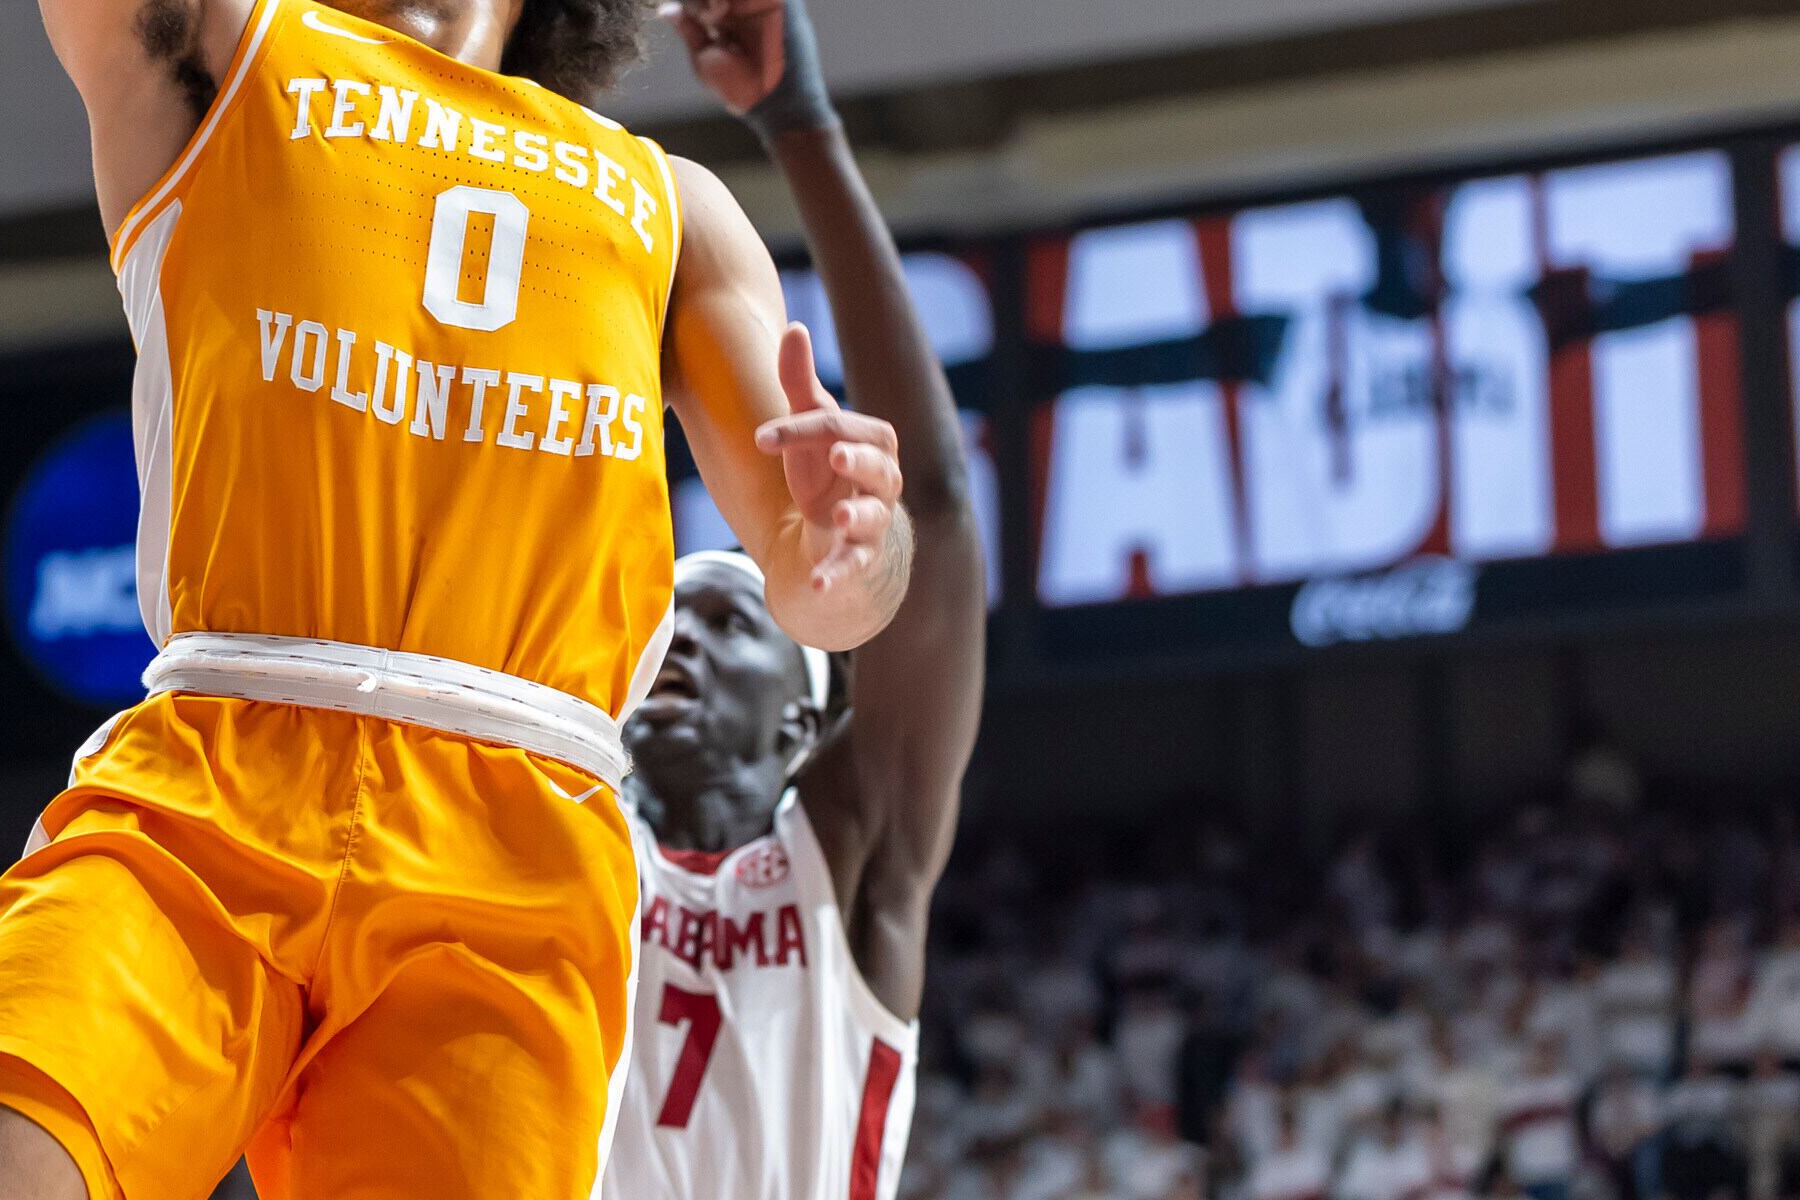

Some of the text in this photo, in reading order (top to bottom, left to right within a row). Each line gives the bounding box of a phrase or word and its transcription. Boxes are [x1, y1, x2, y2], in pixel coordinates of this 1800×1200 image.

[286, 77, 657, 255] TENNESSEE
[421, 184, 530, 332] 0
[255, 308, 646, 462] VOLUNTEERS
[640, 895, 809, 972] ABAMA
[656, 980, 725, 1131] 7
